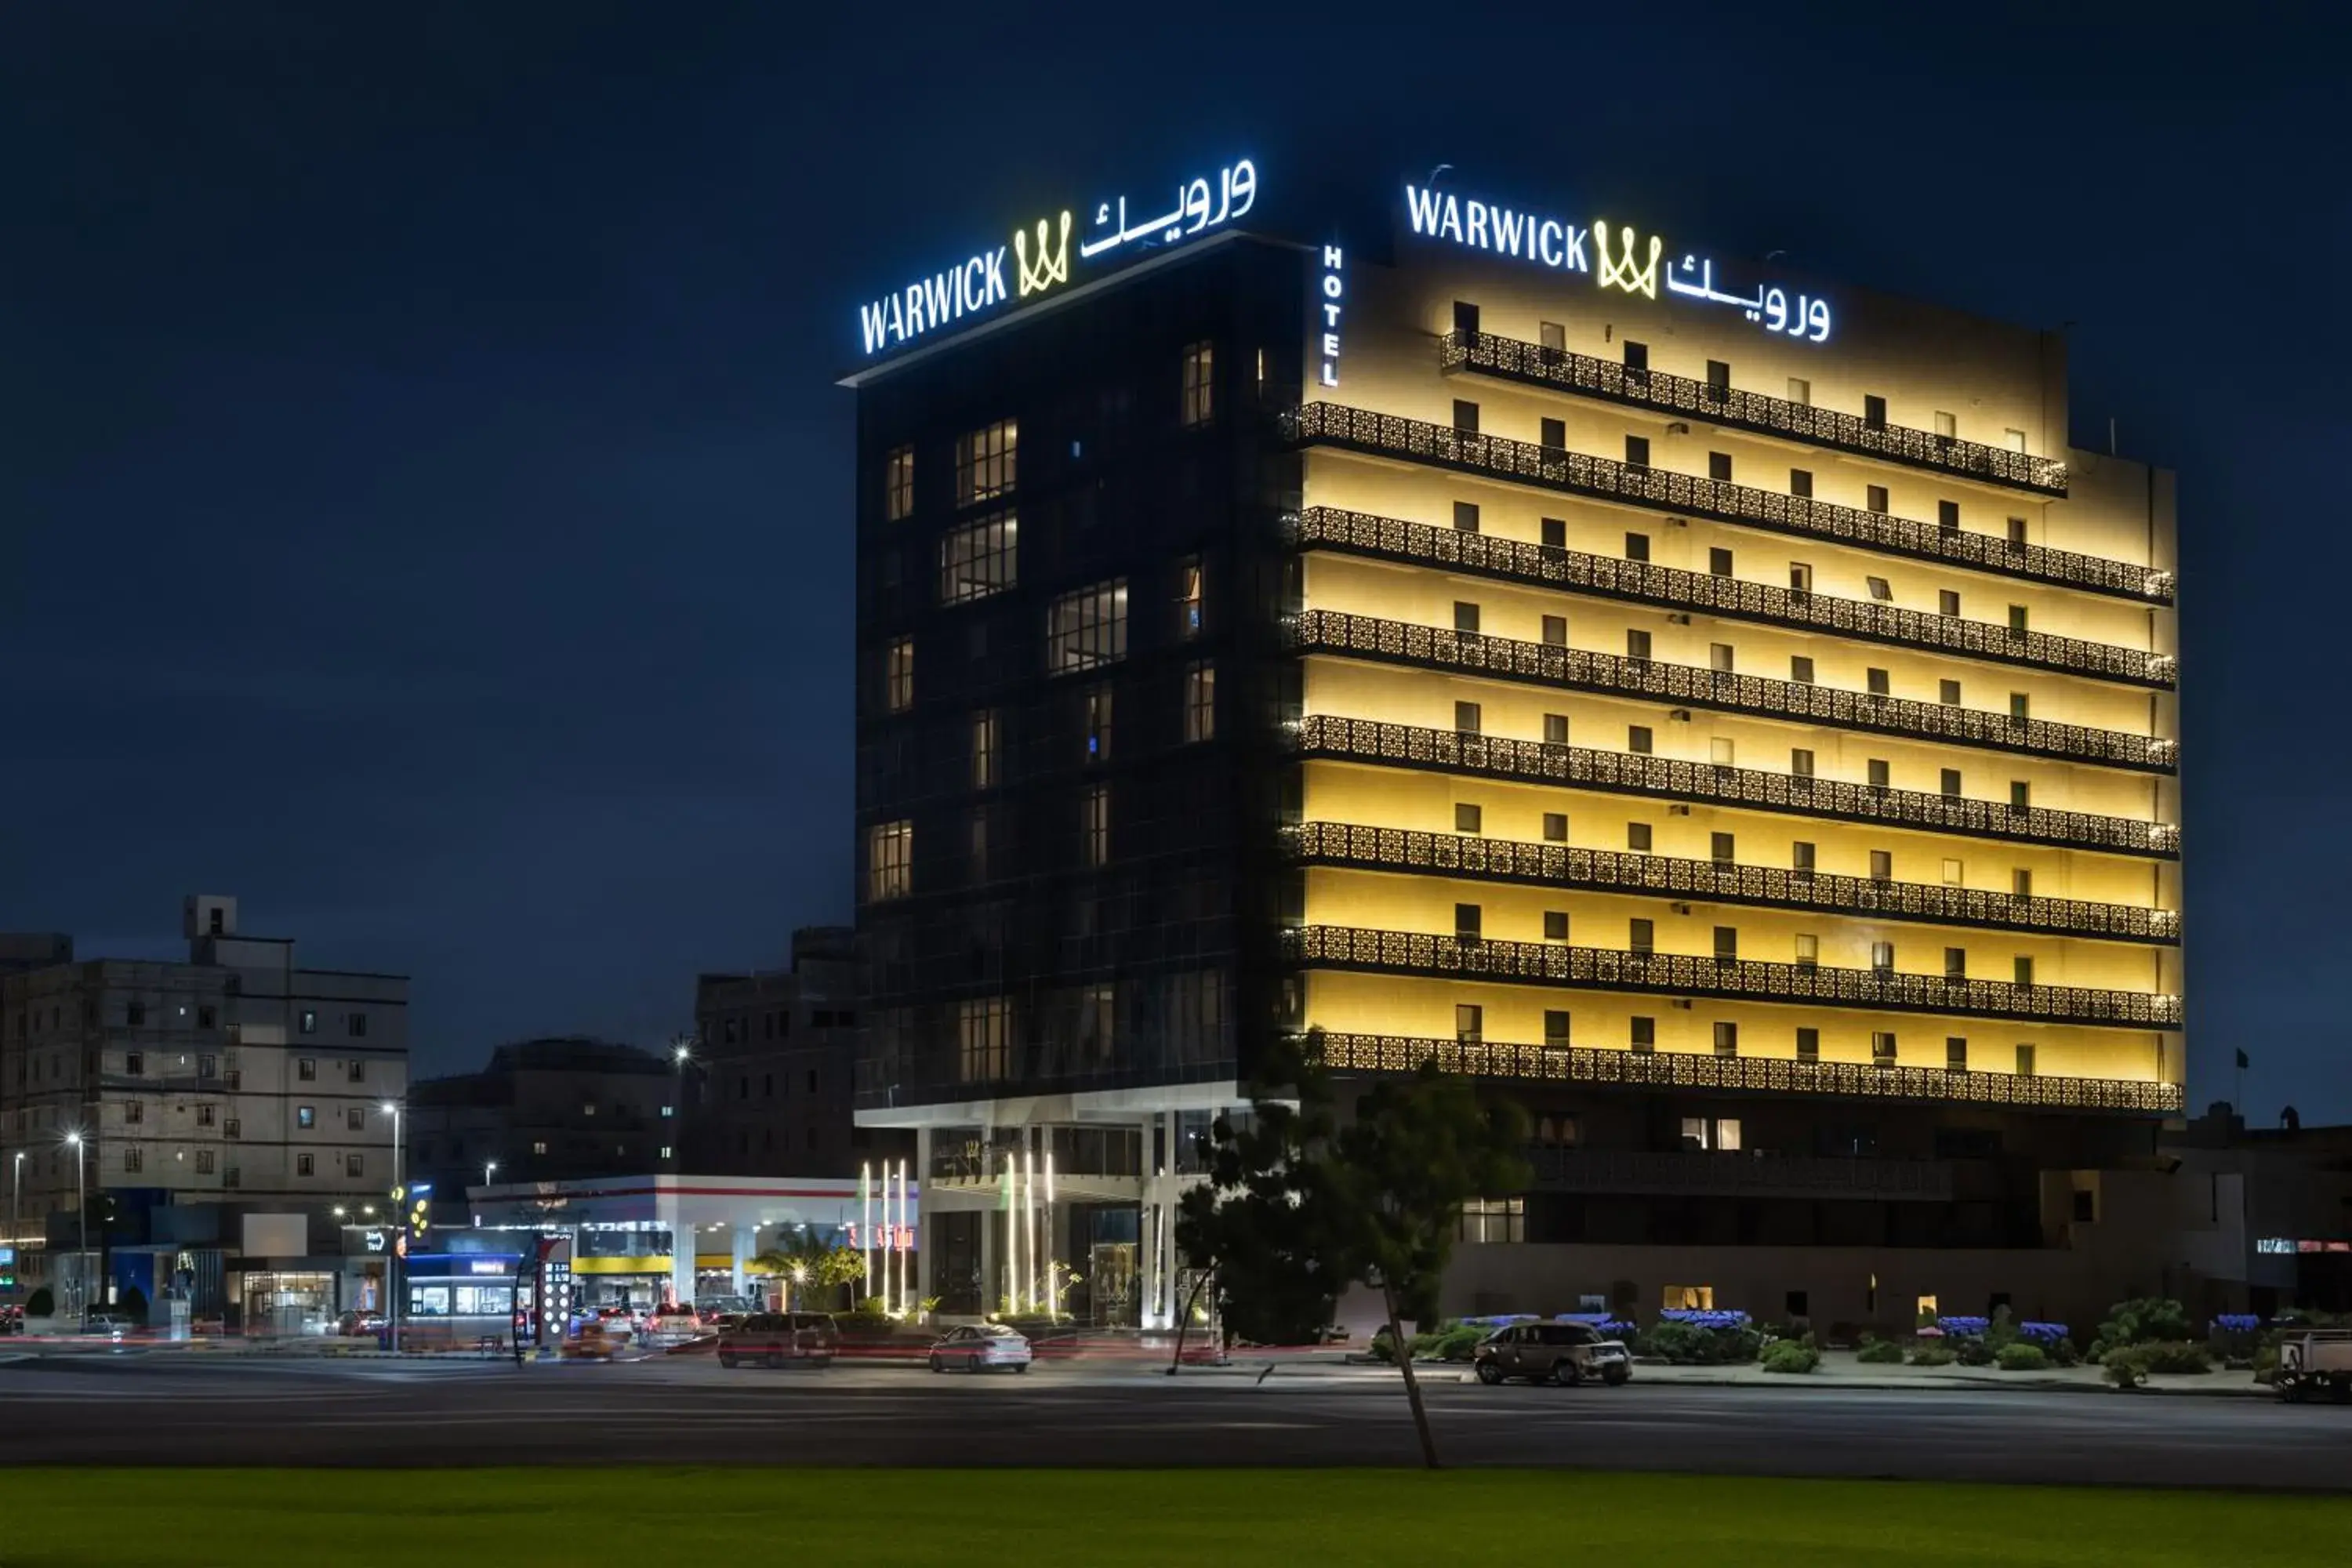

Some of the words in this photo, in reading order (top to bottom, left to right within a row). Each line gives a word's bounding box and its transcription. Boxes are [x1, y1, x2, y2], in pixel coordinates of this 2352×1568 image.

[1081, 159, 1256, 257] ورويك
[1406, 185, 1588, 273] WARWICK
[861, 245, 1007, 354] WARWICK
[1323, 245, 1342, 387] HOTEL
[1667, 254, 1830, 343] ورويك
